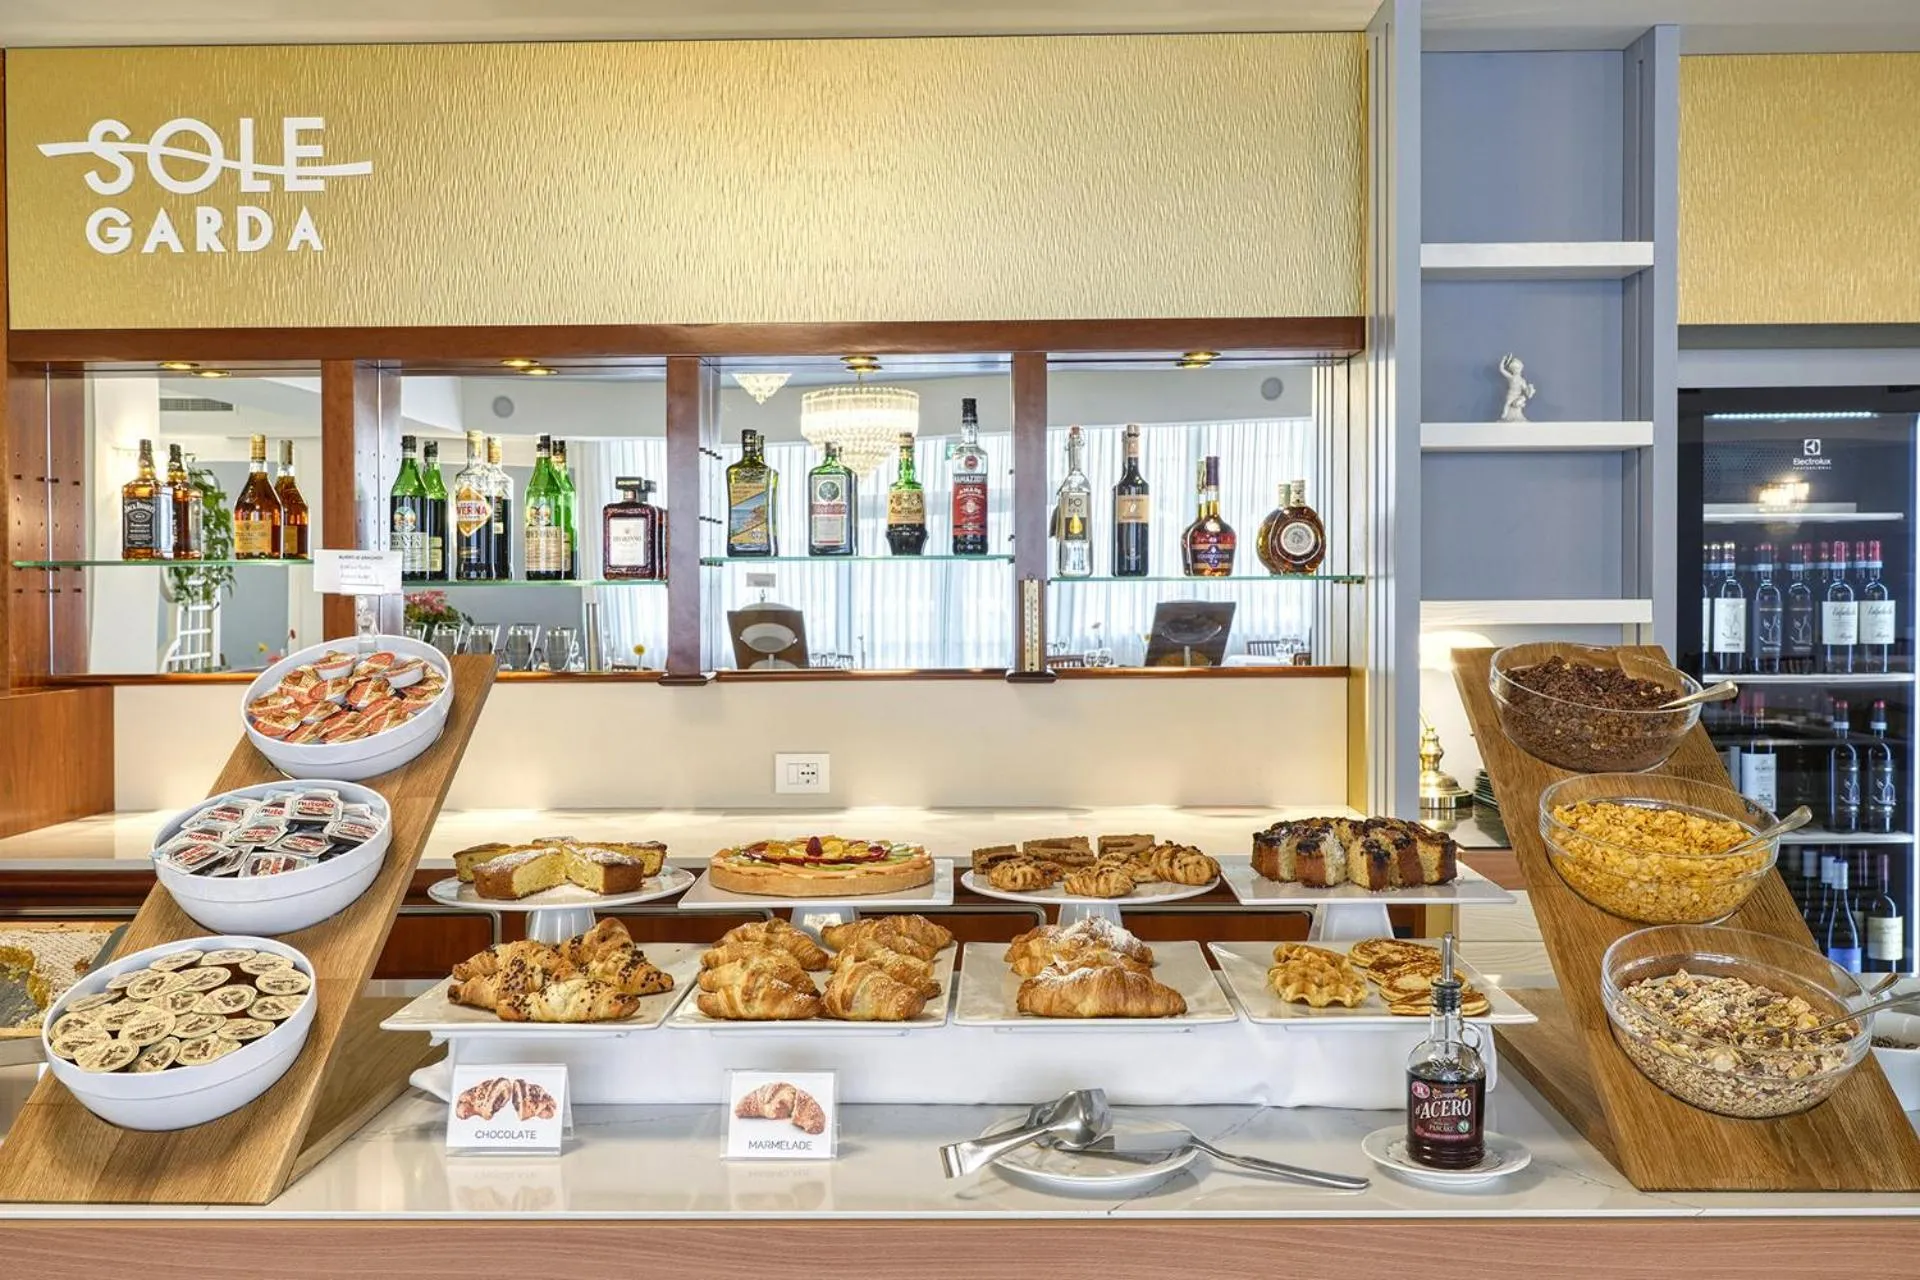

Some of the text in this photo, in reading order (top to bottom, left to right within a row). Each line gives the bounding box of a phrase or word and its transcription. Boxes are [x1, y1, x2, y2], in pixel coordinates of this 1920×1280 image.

[84, 117, 326, 196] SOLE
[85, 205, 325, 254] GARDA
[1793, 456, 1832, 466] Electrolux
[456, 506, 488, 516] VERNA
[297, 800, 336, 810] nutella
[1415, 1098, 1473, 1120] d'ACERO
[474, 1129, 537, 1141] CHOCOLATE
[747, 1139, 813, 1152] MARMELADE
